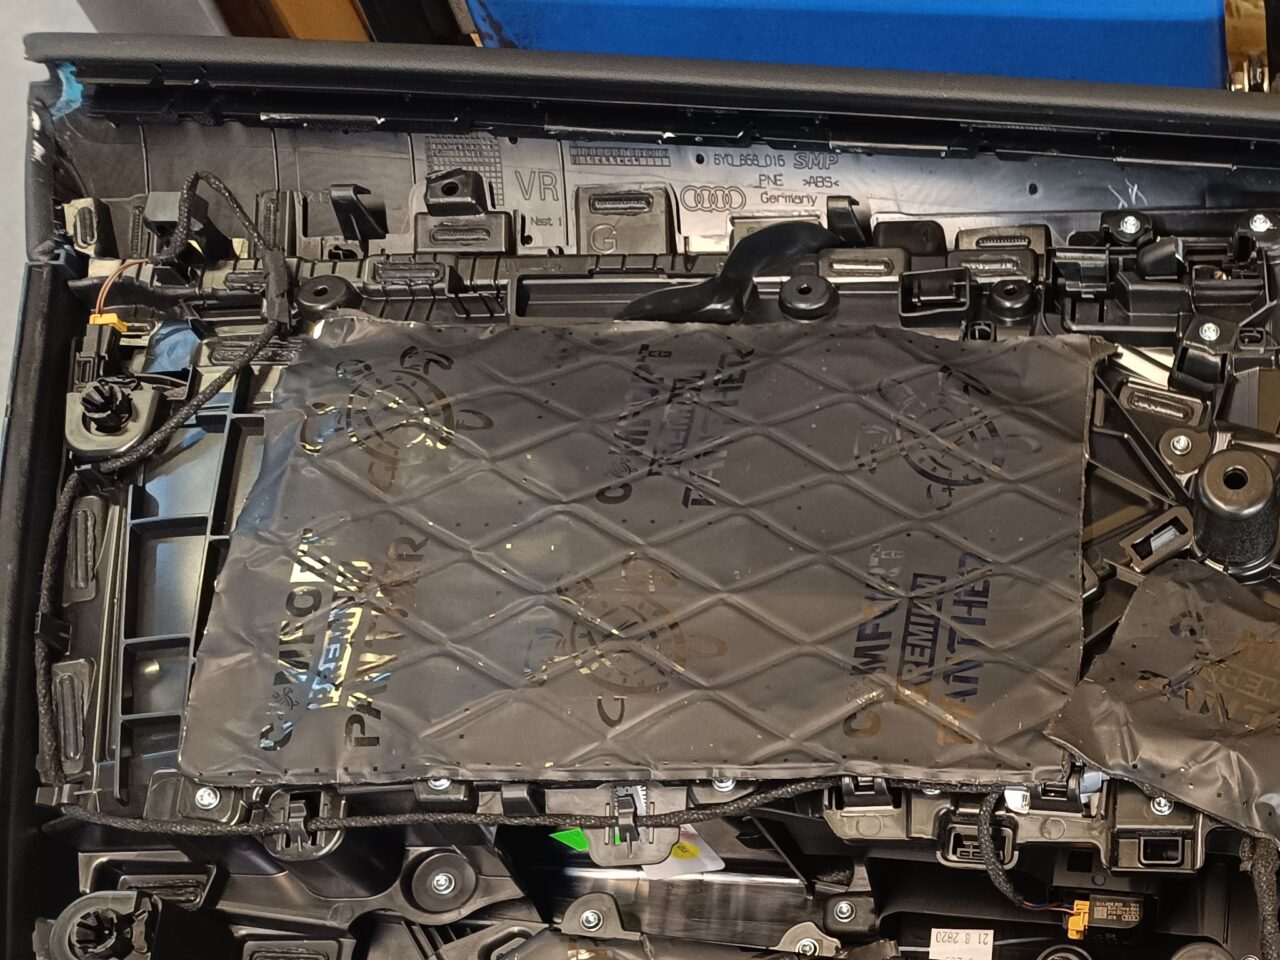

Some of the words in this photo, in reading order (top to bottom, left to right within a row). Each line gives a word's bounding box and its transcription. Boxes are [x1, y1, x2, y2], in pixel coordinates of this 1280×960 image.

[793, 152, 839, 170] SMP
[515, 170, 559, 201] VR
[758, 173, 784, 187] PNE
[760, 191, 818, 207] Germany
